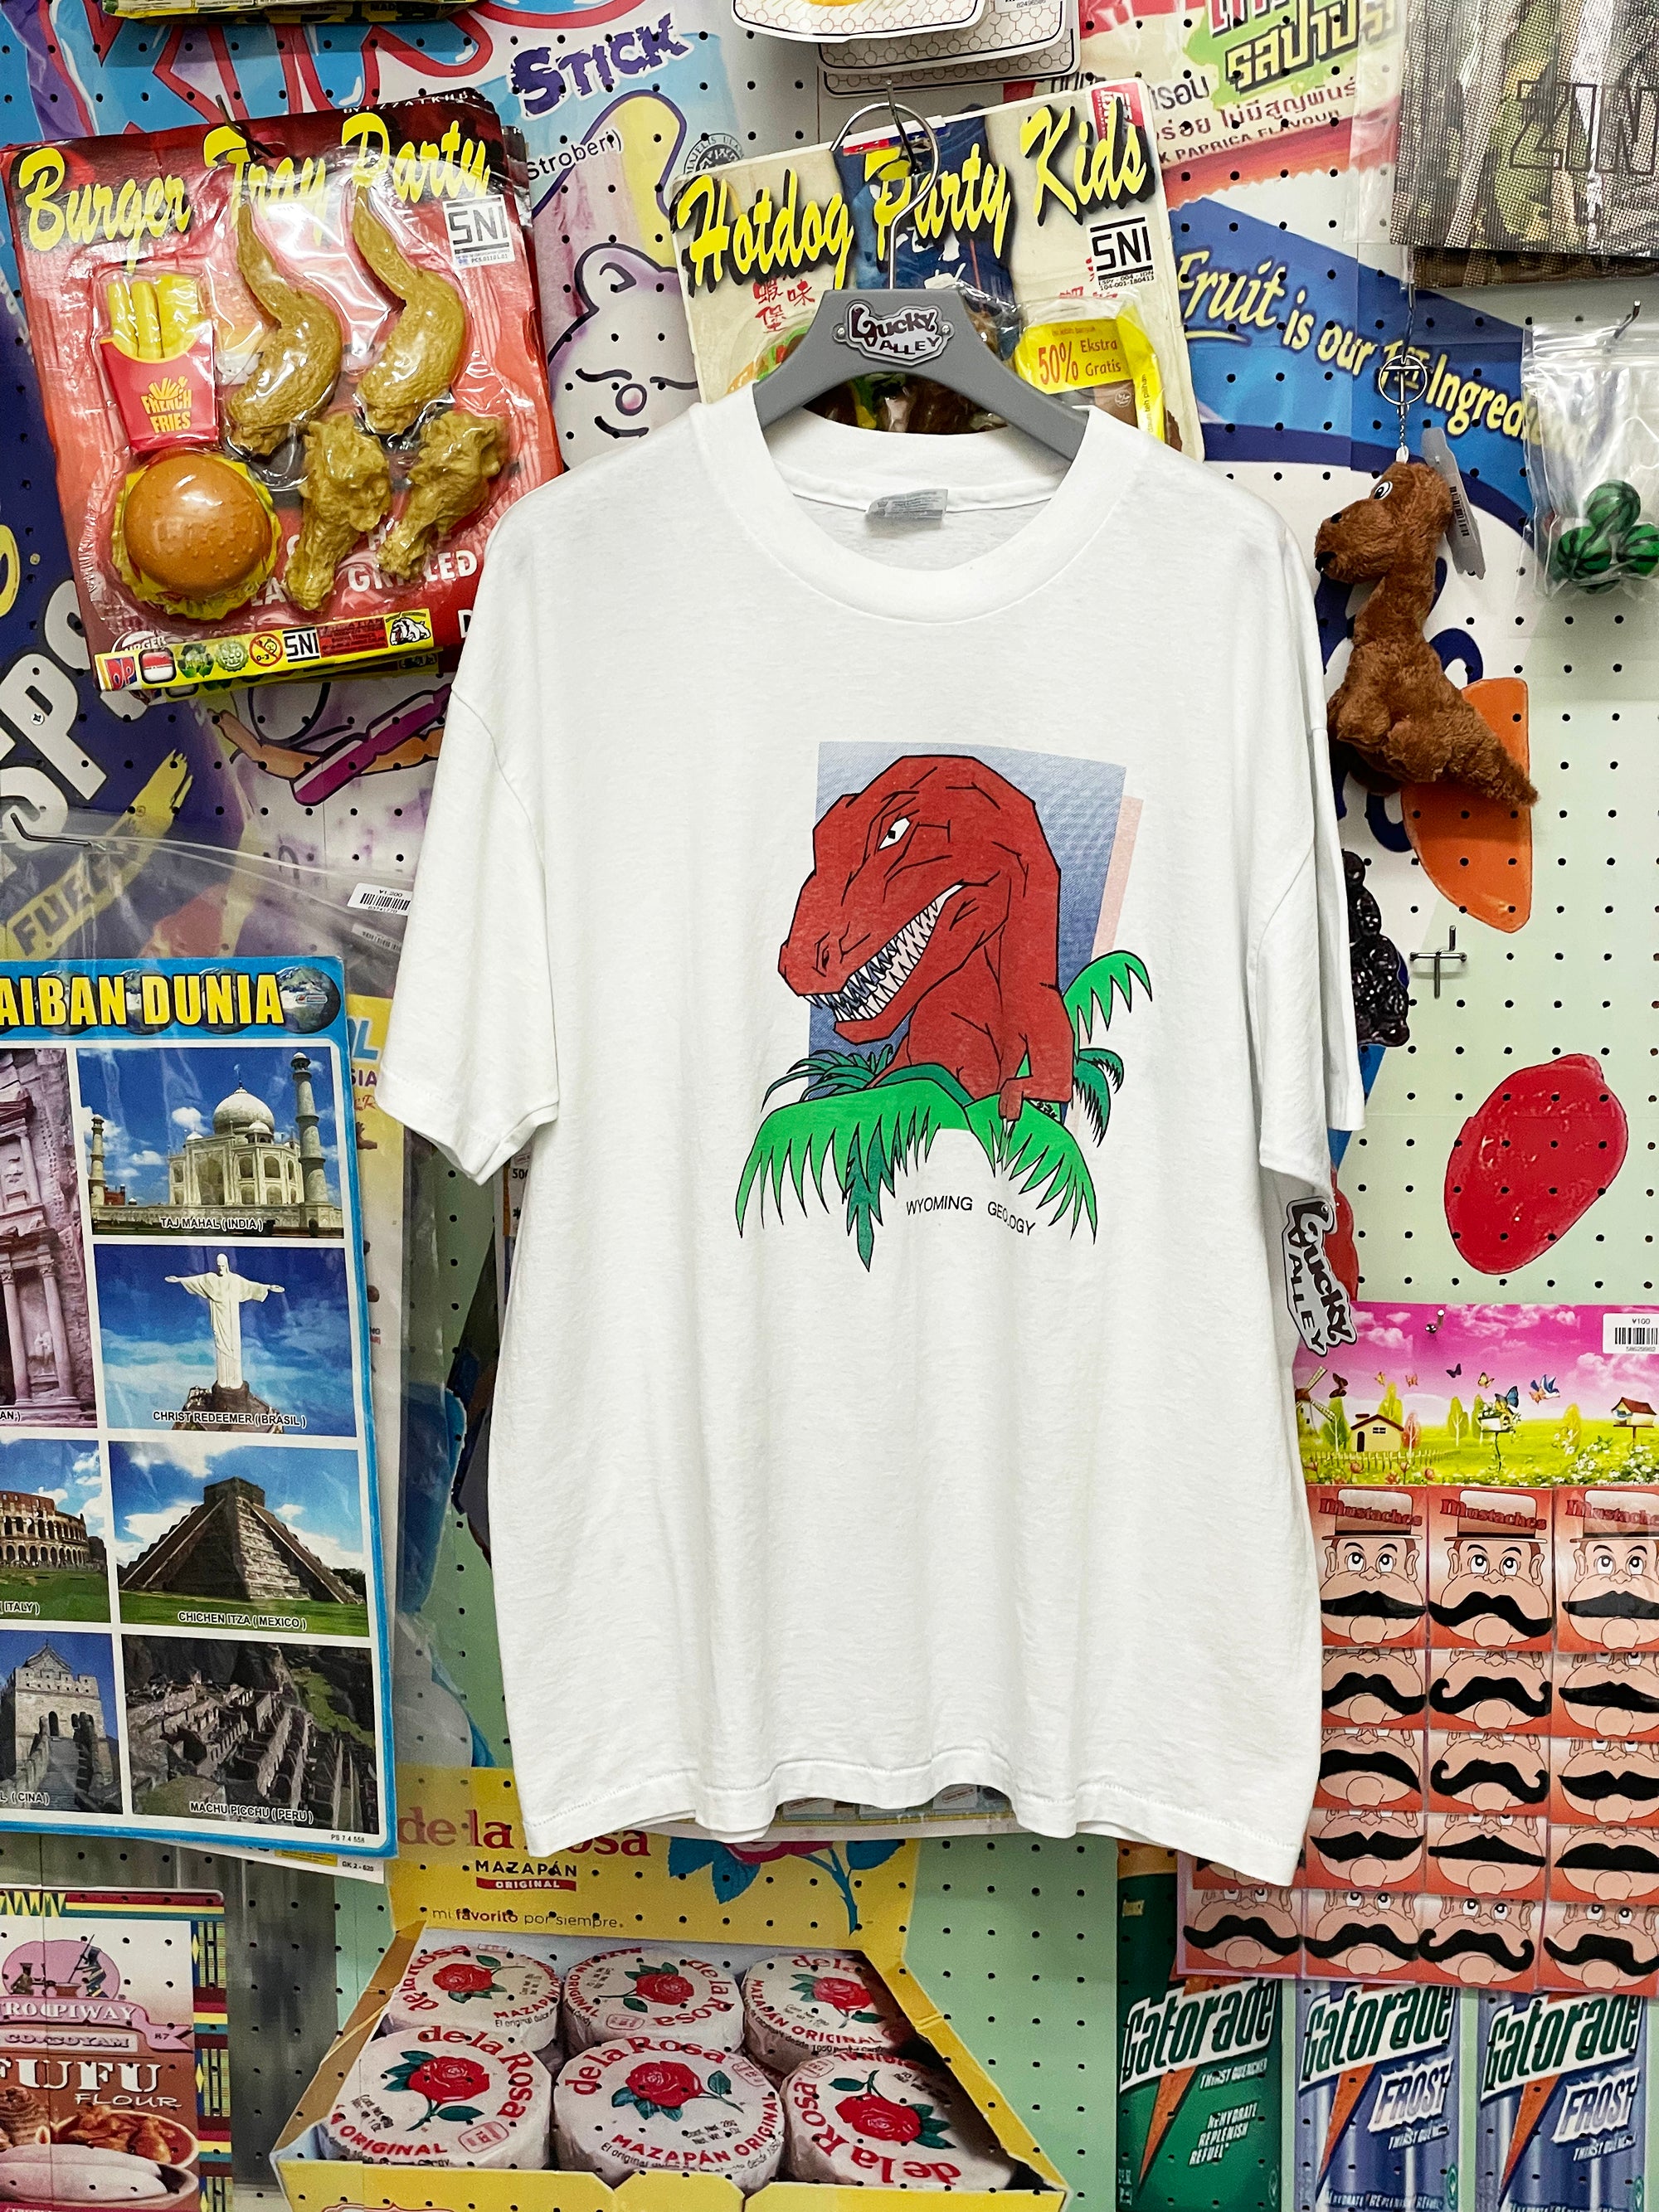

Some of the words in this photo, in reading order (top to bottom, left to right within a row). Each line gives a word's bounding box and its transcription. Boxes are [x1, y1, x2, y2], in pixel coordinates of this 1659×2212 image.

[509, 12, 690, 115] STICK
[19, 148, 192, 275] Burger
[342, 112, 491, 204] Party
[677, 168, 854, 290] Hotdog
[864, 143, 1011, 260] Party
[1020, 97, 1148, 217] Kids
[448, 205, 508, 246] SNI
[1092, 226, 1151, 271] SNI
[1178, 250, 1287, 327] Fruit
[1282, 289, 1314, 349] is
[1316, 328, 1379, 375] our
[1081, 338, 1118, 353] Ekstra
[1039, 341, 1078, 386] 50%
[1086, 359, 1122, 377] Gratis
[149, 411, 191, 435] FRIES
[285, 631, 320, 657] SNI
[142, 975, 285, 1025] DUNIA
[906, 1195, 974, 1216] WYOMING
[161, 1218, 179, 1228] TAJ
[182, 1218, 220, 1228] MAHAL
[153, 1411, 192, 1422] CHRIST
[193, 1412, 254, 1424] REDEEMER
[1318, 1497, 1423, 1528] Mustaches
[1440, 1498, 1548, 1531] Mustaches
[178, 1612, 226, 1624] CHICHEN
[227, 1613, 251, 1625] ITZA
[190, 1801, 228, 1815] MACHU
[229, 1804, 270, 1819] PICCHU
[397, 1806, 456, 1847] de
[466, 1809, 516, 1849] la
[475, 1860, 578, 1878] MAZAPÁN
[494, 1879, 561, 1890] ORIGINAL
[432, 1908, 451, 1920] mi
[456, 1908, 518, 1923] favorito
[524, 1915, 552, 1927] por
[1121, 1978, 1277, 2084] Gatorade
[1300, 1983, 1452, 2083] Gatorade
[1483, 1994, 1642, 2090] Gatorade
[583, 2046, 629, 2069] la
[625, 2035, 727, 2064] Rosa
[417, 2025, 469, 2044] de
[466, 2030, 504, 2056] la
[498, 2051, 535, 2119] Rosa
[565, 2065, 603, 2096] de
[75, 2093, 182, 2108] FLOUR
[1374, 2064, 1450, 2123] FROST
[1559, 2074, 1637, 2136] FROST
[611, 2134, 732, 2166] MAZAPÁN
[733, 2097, 778, 2156] ORIGINAL
[793, 2081, 850, 2157] Rosa
[339, 2125, 449, 2156] ORIGINAL
[1198, 2122, 1250, 2149] REPLENISH
[601, 2142, 610, 2152] El
[611, 2148, 649, 2169] original
[850, 2145, 896, 2184] la
[902, 2161, 962, 2185] de
